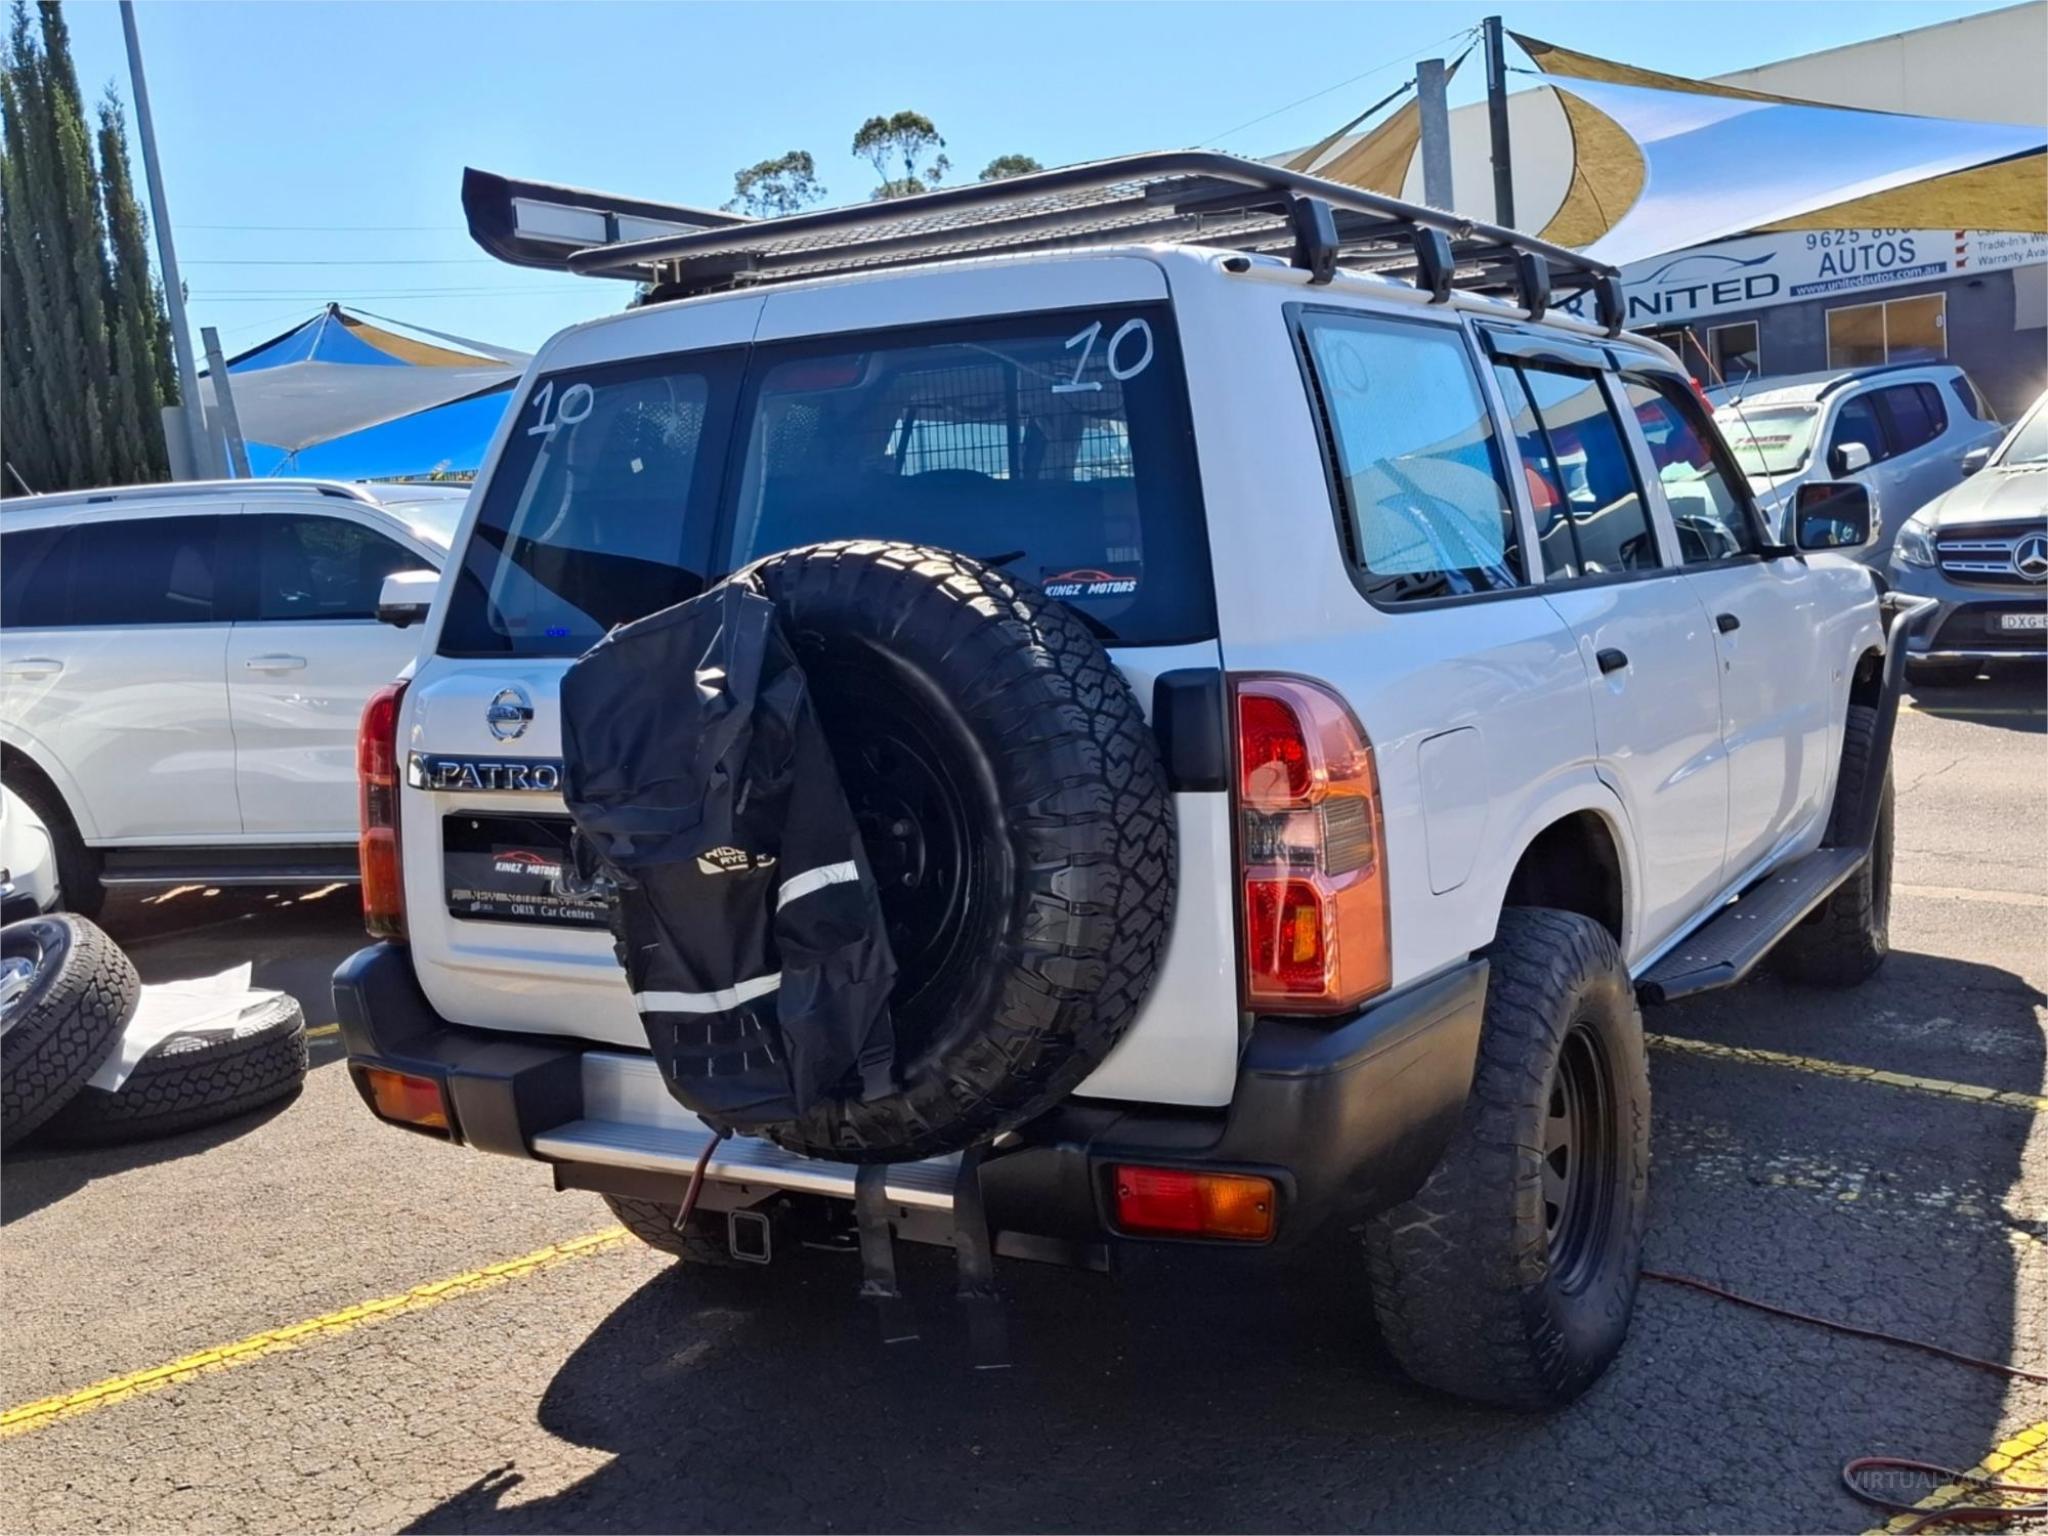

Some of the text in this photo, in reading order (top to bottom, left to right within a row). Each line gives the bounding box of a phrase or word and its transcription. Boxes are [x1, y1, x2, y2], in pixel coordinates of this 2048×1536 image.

[1819, 238, 1916, 278] AUTOS
[1977, 252, 2023, 266] Warranty
[1796, 264, 1941, 295] www.unitedautos.com.au
[1595, 273, 1780, 321] NITED
[1051, 318, 1153, 393] 10
[527, 380, 594, 436] 10
[1044, 580, 1137, 597] KINGZ MOTORS
[437, 761, 560, 791] PATRO
[495, 861, 562, 877] KINGZ MOTORS
[511, 904, 596, 920] ORIX Car Centres
